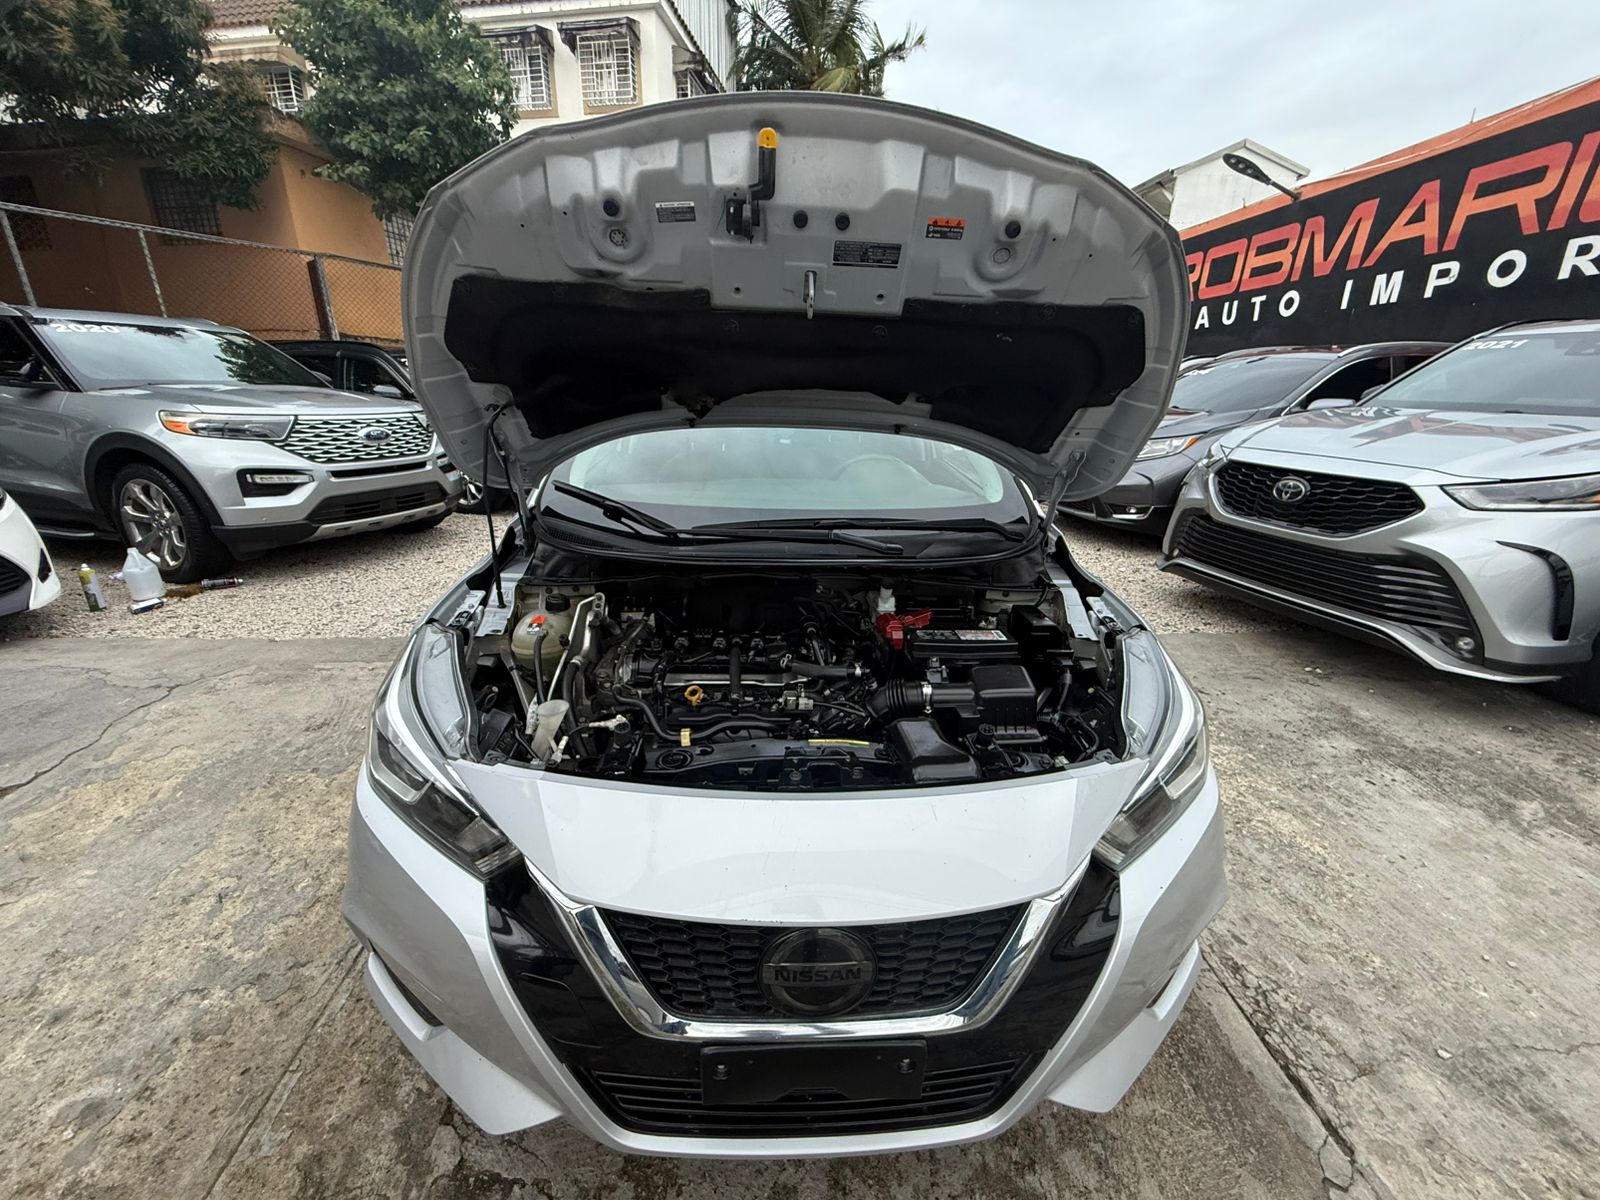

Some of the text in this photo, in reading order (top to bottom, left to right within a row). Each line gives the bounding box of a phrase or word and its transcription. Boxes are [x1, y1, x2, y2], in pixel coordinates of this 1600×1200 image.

[1185, 130, 1600, 302] OBMARI
[1194, 234, 1600, 330] AUTO IMPOR
[50, 323, 121, 334] 2020
[1462, 339, 1529, 351] 2021
[775, 966, 862, 983] NISSAN
